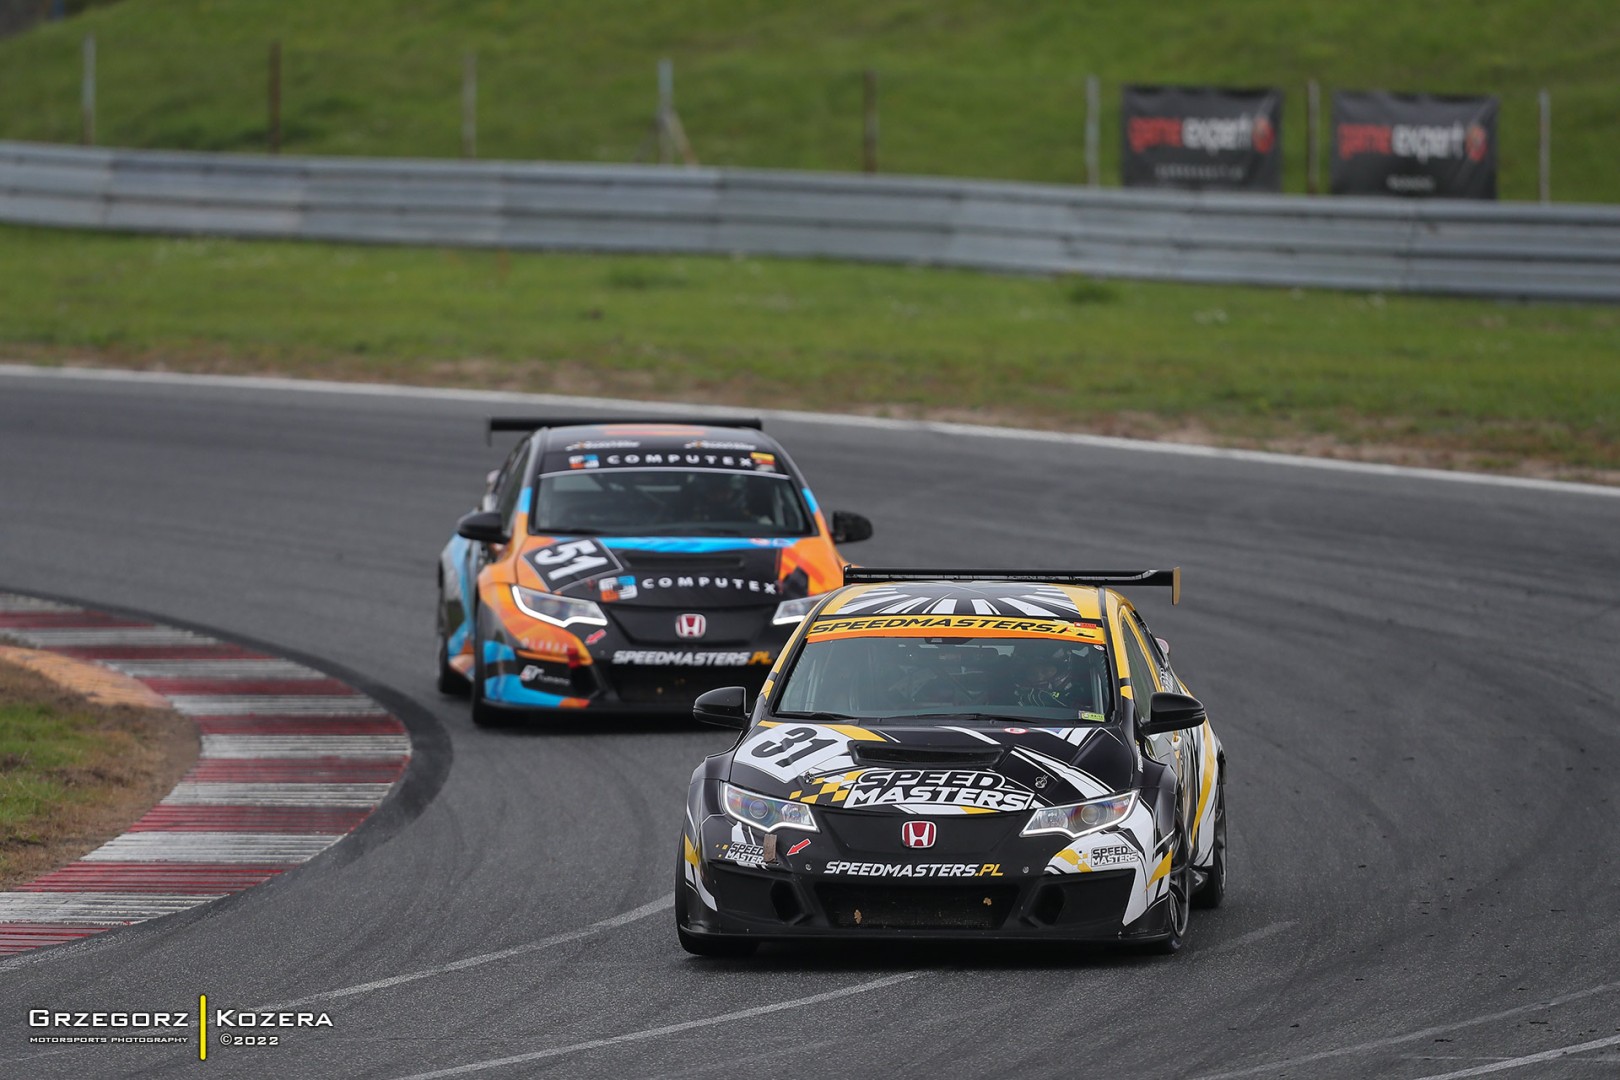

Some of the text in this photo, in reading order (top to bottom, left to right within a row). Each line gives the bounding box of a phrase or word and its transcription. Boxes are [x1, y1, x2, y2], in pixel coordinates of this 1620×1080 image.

[606, 453, 752, 467] COMPUTEX
[534, 539, 608, 581] 51
[642, 576, 776, 595] COMPUTEX
[612, 650, 772, 666] SPEEDMASTERS.PL
[751, 727, 839, 768] 31
[856, 769, 1006, 790] SPEED
[845, 785, 1035, 810] MASTERS
[725, 850, 767, 865] MASTER
[1091, 853, 1137, 866] MASTERS
[1092, 846, 1128, 857] SPEED
[824, 860, 1004, 878] SPEEDMASTERS.PL
